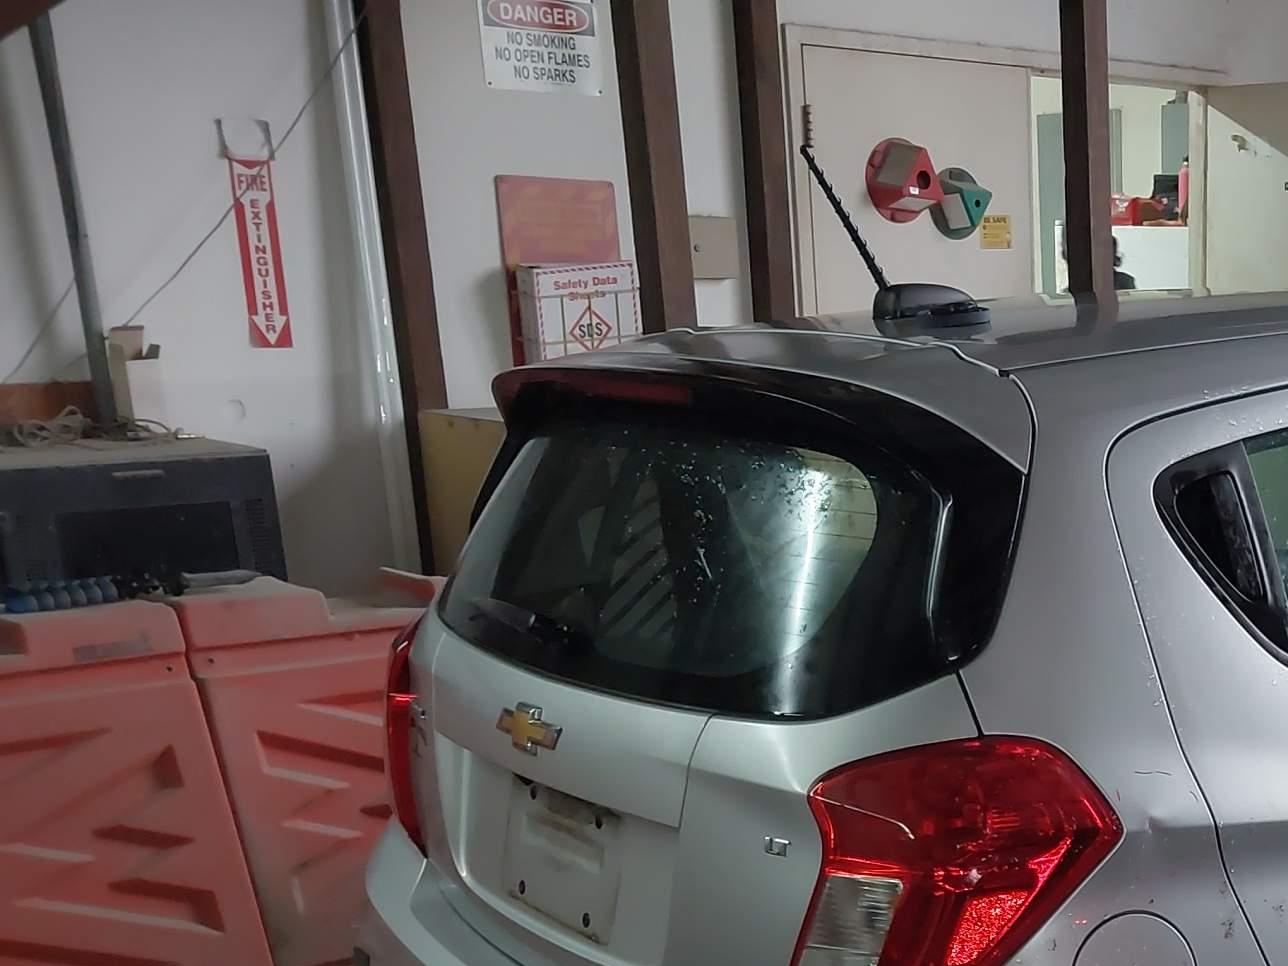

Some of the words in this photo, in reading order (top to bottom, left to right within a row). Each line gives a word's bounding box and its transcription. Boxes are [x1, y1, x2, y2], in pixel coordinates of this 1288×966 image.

[499, 2, 577, 27] DANGER
[507, 31, 523, 46] NO
[526, 33, 576, 50] SMOKING
[495, 46, 511, 62] NO
[514, 49, 544, 64] OPEN
[548, 52, 590, 69] FLAMES
[514, 65, 530, 80] NO
[533, 67, 577, 83] SPARKS
[237, 173, 267, 192] FIRE
[250, 199, 276, 334] EXTINGUISHER
[553, 279, 589, 291] Safety
[592, 276, 618, 287] Data
[578, 322, 603, 339] SDS
[764, 836, 791, 857] LT
